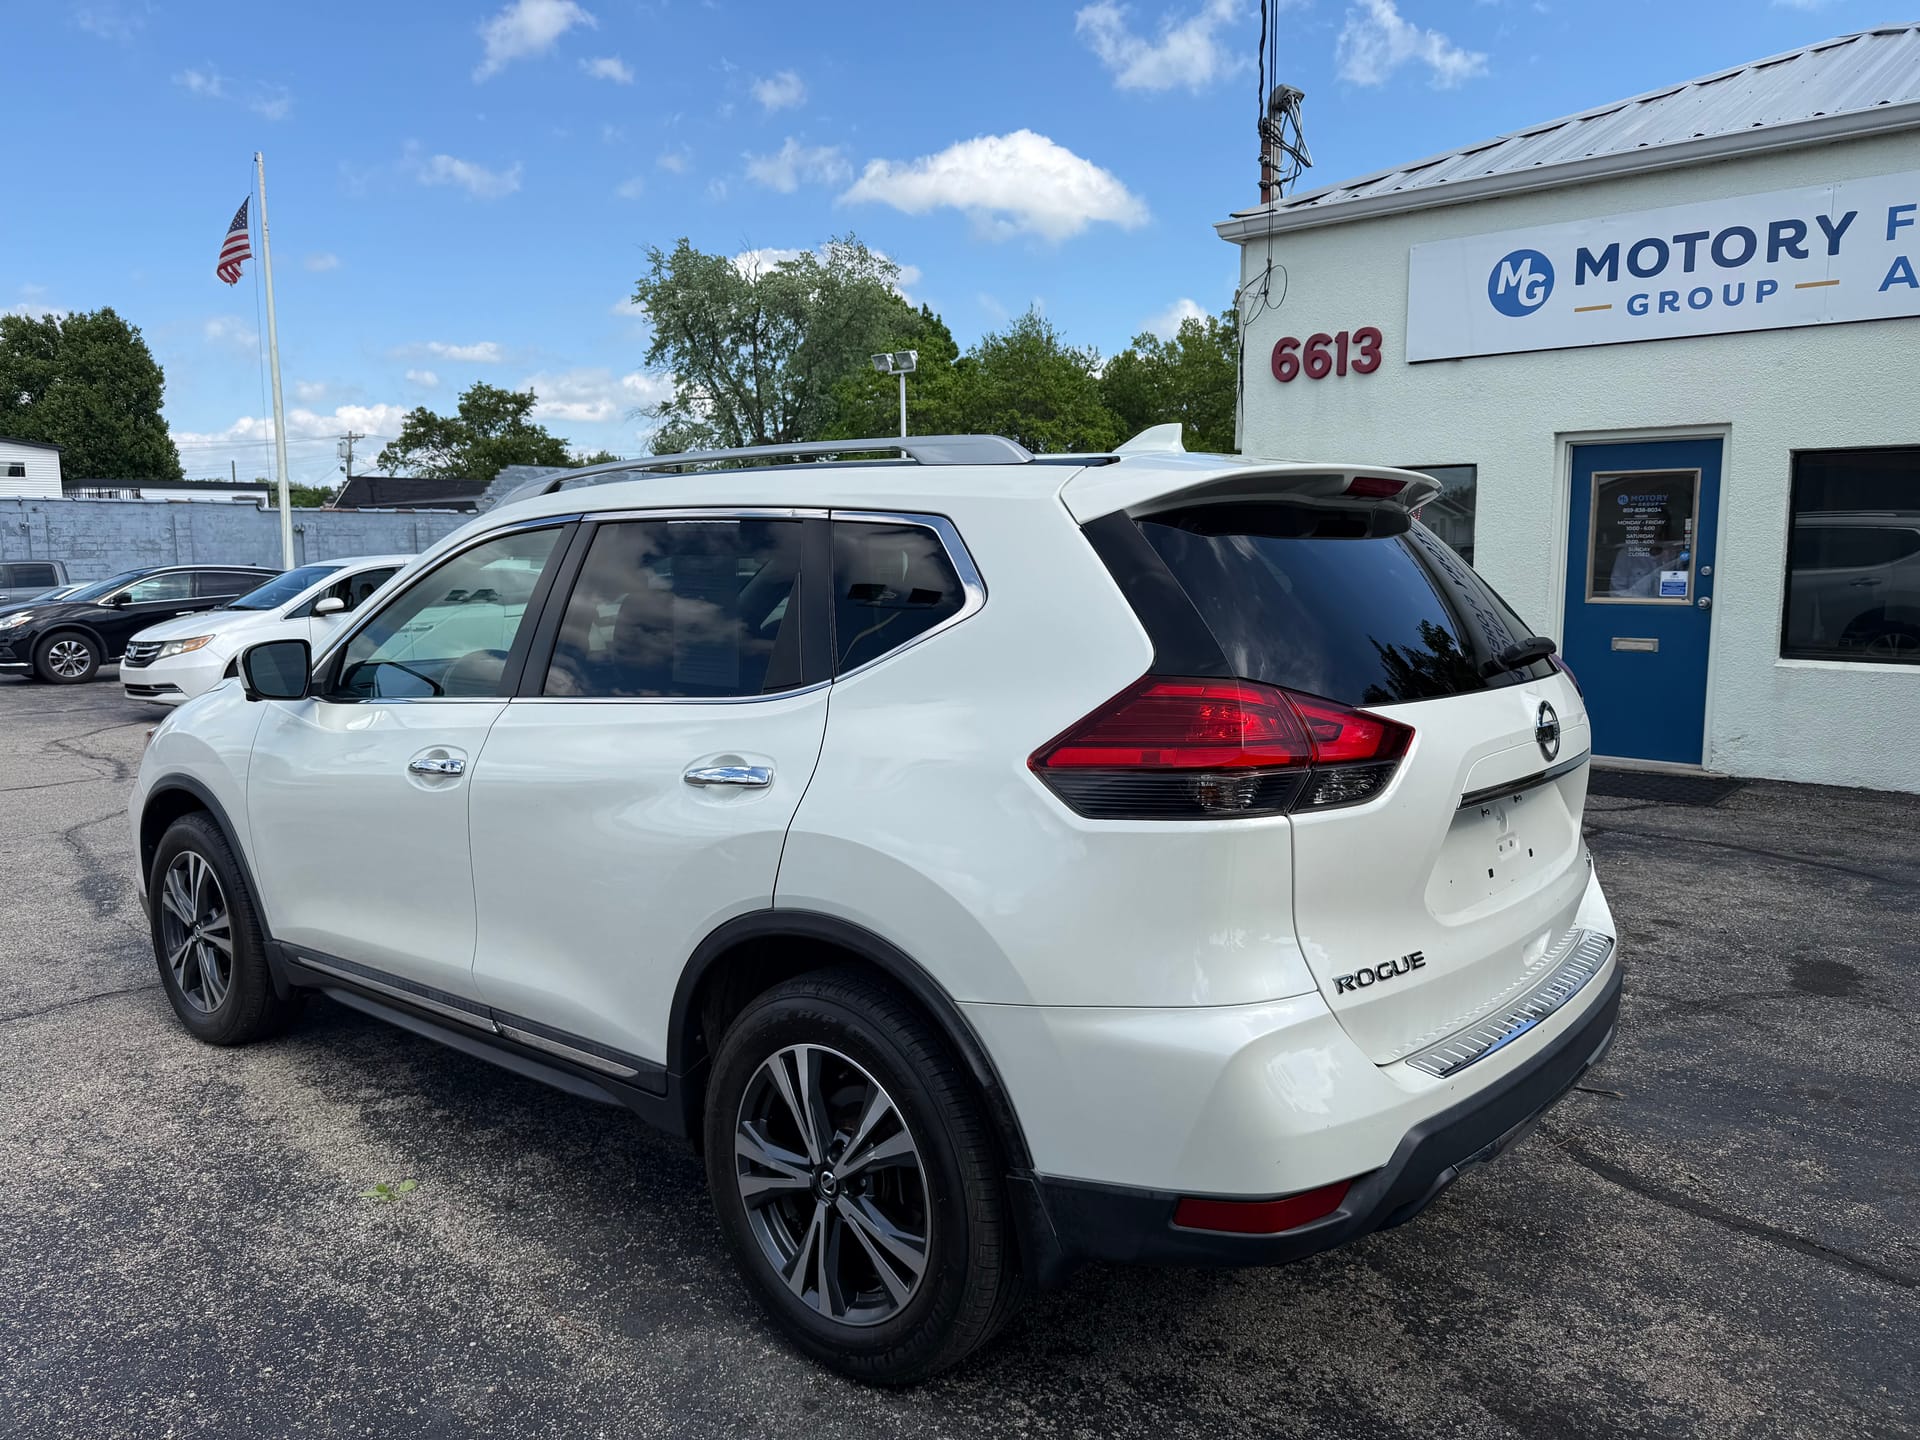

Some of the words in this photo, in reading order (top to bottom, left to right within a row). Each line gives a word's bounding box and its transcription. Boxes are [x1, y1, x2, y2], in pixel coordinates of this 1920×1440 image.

[1886, 203, 1918, 241] F
[1574, 210, 1859, 286] MOTORY
[1496, 257, 1547, 307] MG
[1878, 255, 1920, 292] A
[1626, 278, 1779, 316] GROUP
[1271, 326, 1383, 383] 6613
[1630, 494, 1668, 502] MOTORY
[1332, 950, 1427, 995] ROGUE
